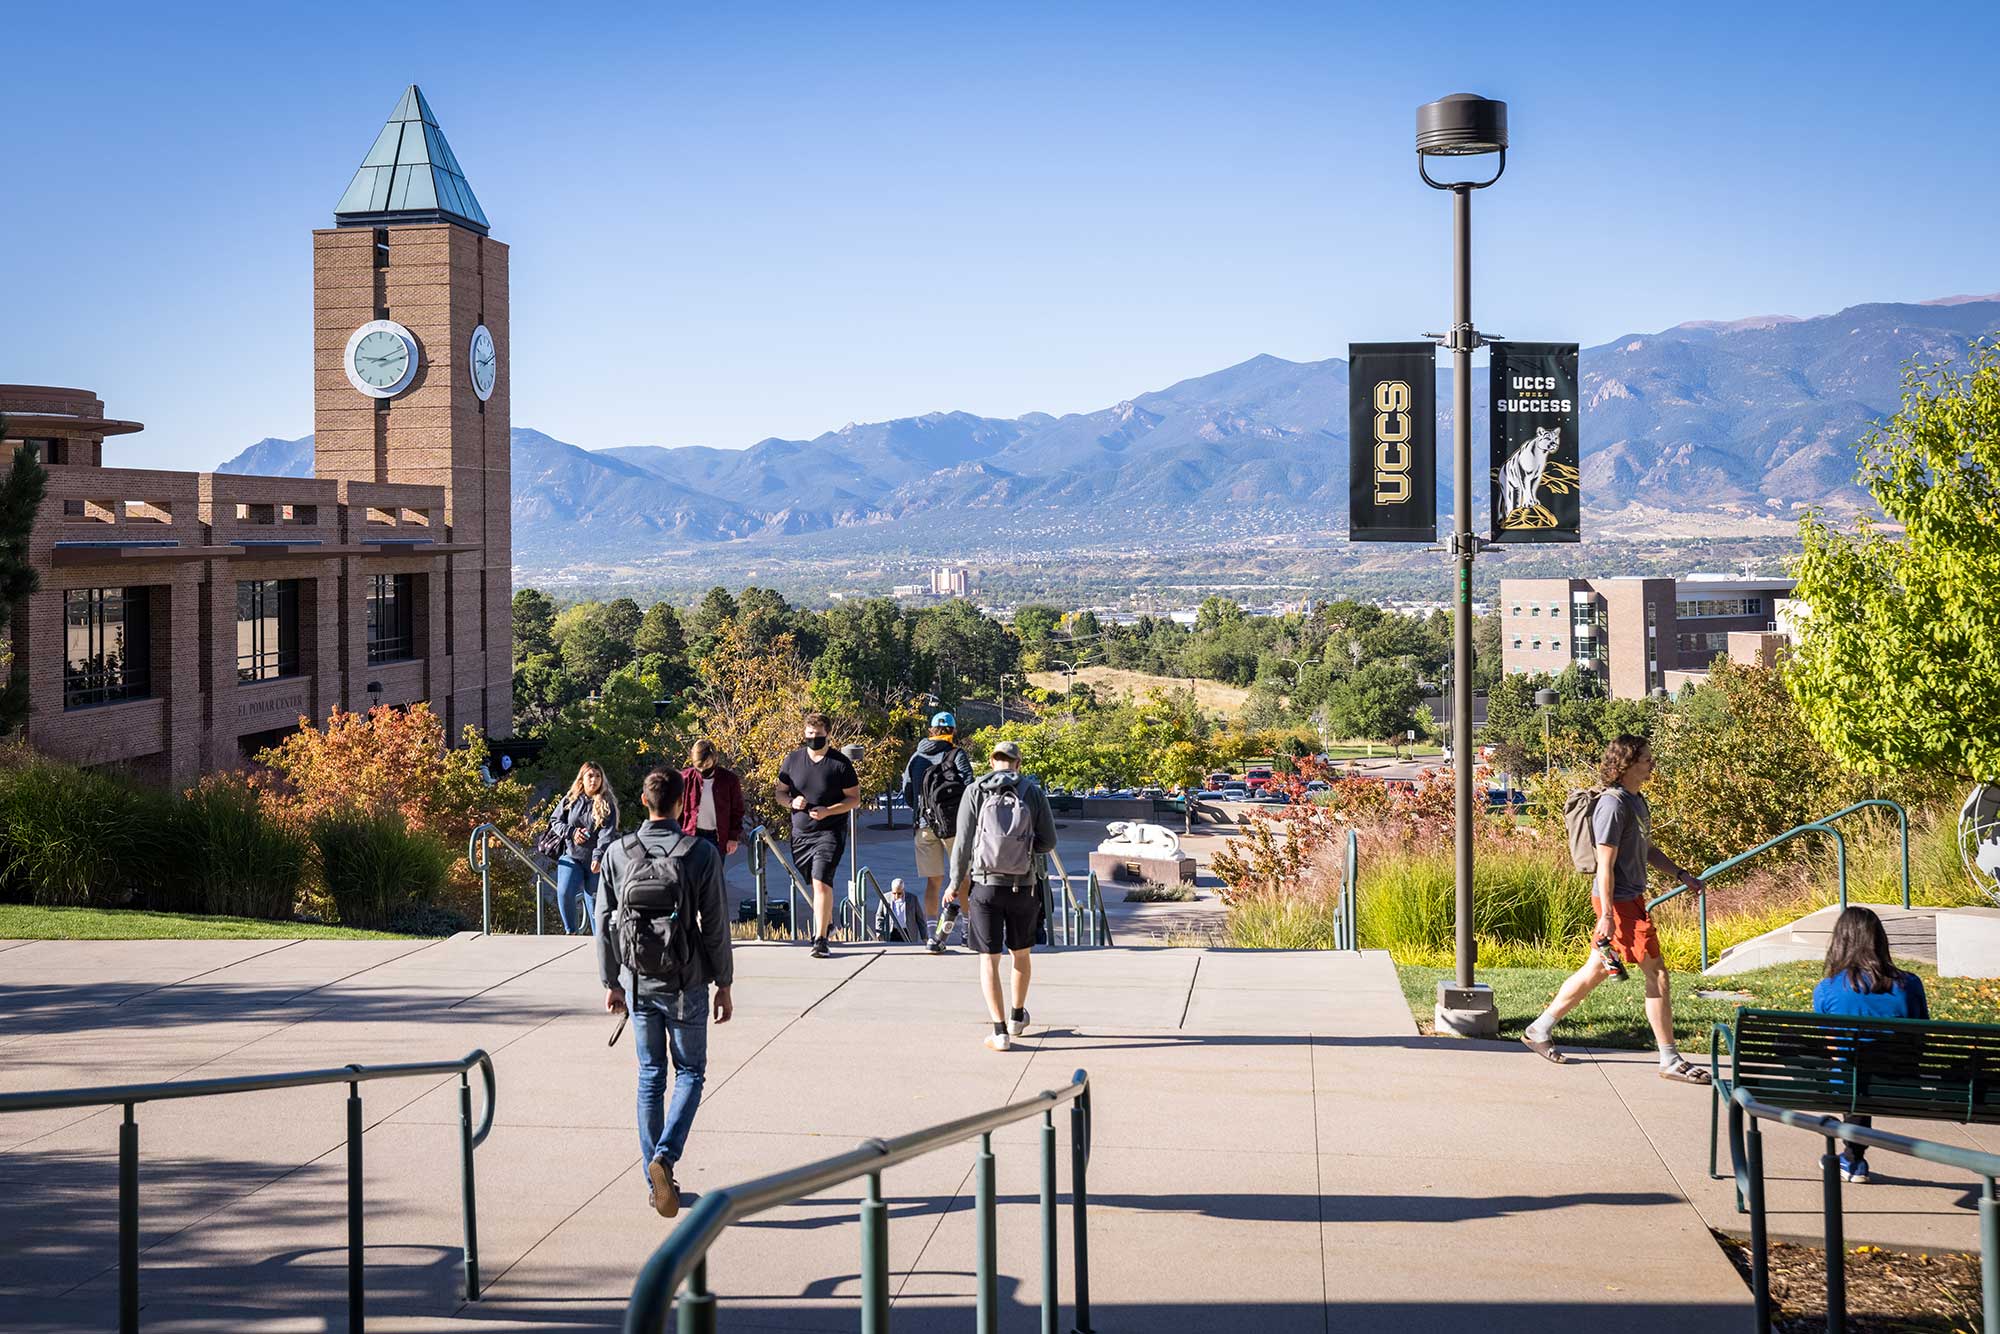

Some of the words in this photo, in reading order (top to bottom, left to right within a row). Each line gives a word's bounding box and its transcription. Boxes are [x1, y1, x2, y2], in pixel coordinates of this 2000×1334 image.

[1512, 376, 1556, 390] UCCS
[1497, 399, 1572, 413] SUCCESS
[1374, 380, 1412, 506] UCCS
[249, 700, 275, 715] POMAR
[275, 694, 303, 711] CENTER
